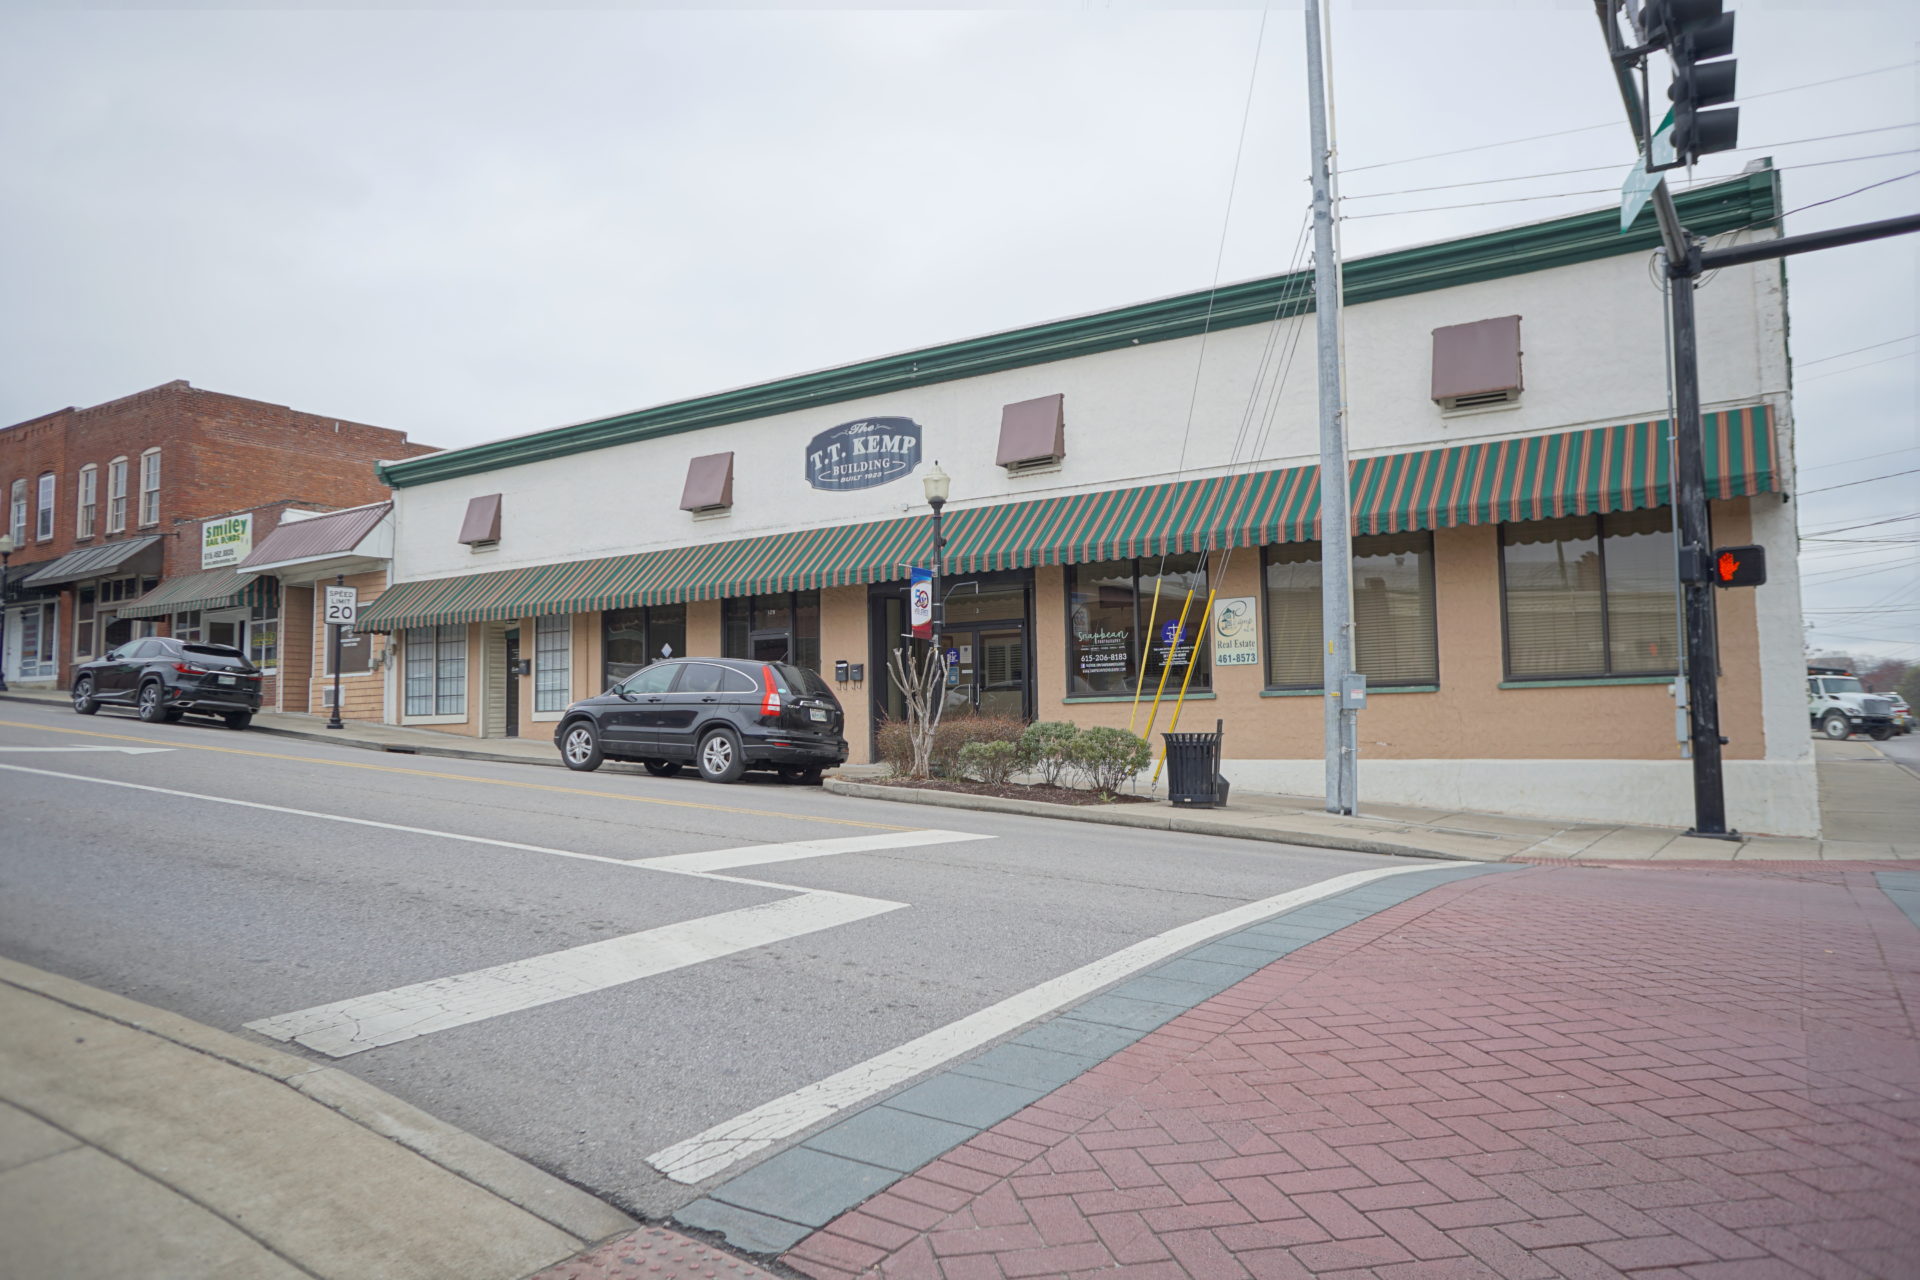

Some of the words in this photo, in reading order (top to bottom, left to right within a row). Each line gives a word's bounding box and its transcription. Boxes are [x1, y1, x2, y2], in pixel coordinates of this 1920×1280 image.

[849, 422, 875, 435] The
[810, 443, 846, 470] T.T.
[852, 435, 917, 456] KEMP
[833, 458, 890, 476] BUILDING
[840, 475, 862, 483] BUILT
[206, 519, 248, 539] smiley
[206, 536, 220, 547] BAIL
[220, 534, 241, 545] BONDS
[329, 590, 353, 598] SPEED
[329, 605, 353, 620] 20
[1078, 627, 1129, 645] Snapbean
[1217, 639, 1233, 649] Real
[1234, 638, 1256, 649] Estate
[1080, 653, 1127, 662] 615-206-8183
[1217, 653, 1256, 664] 461-8573
